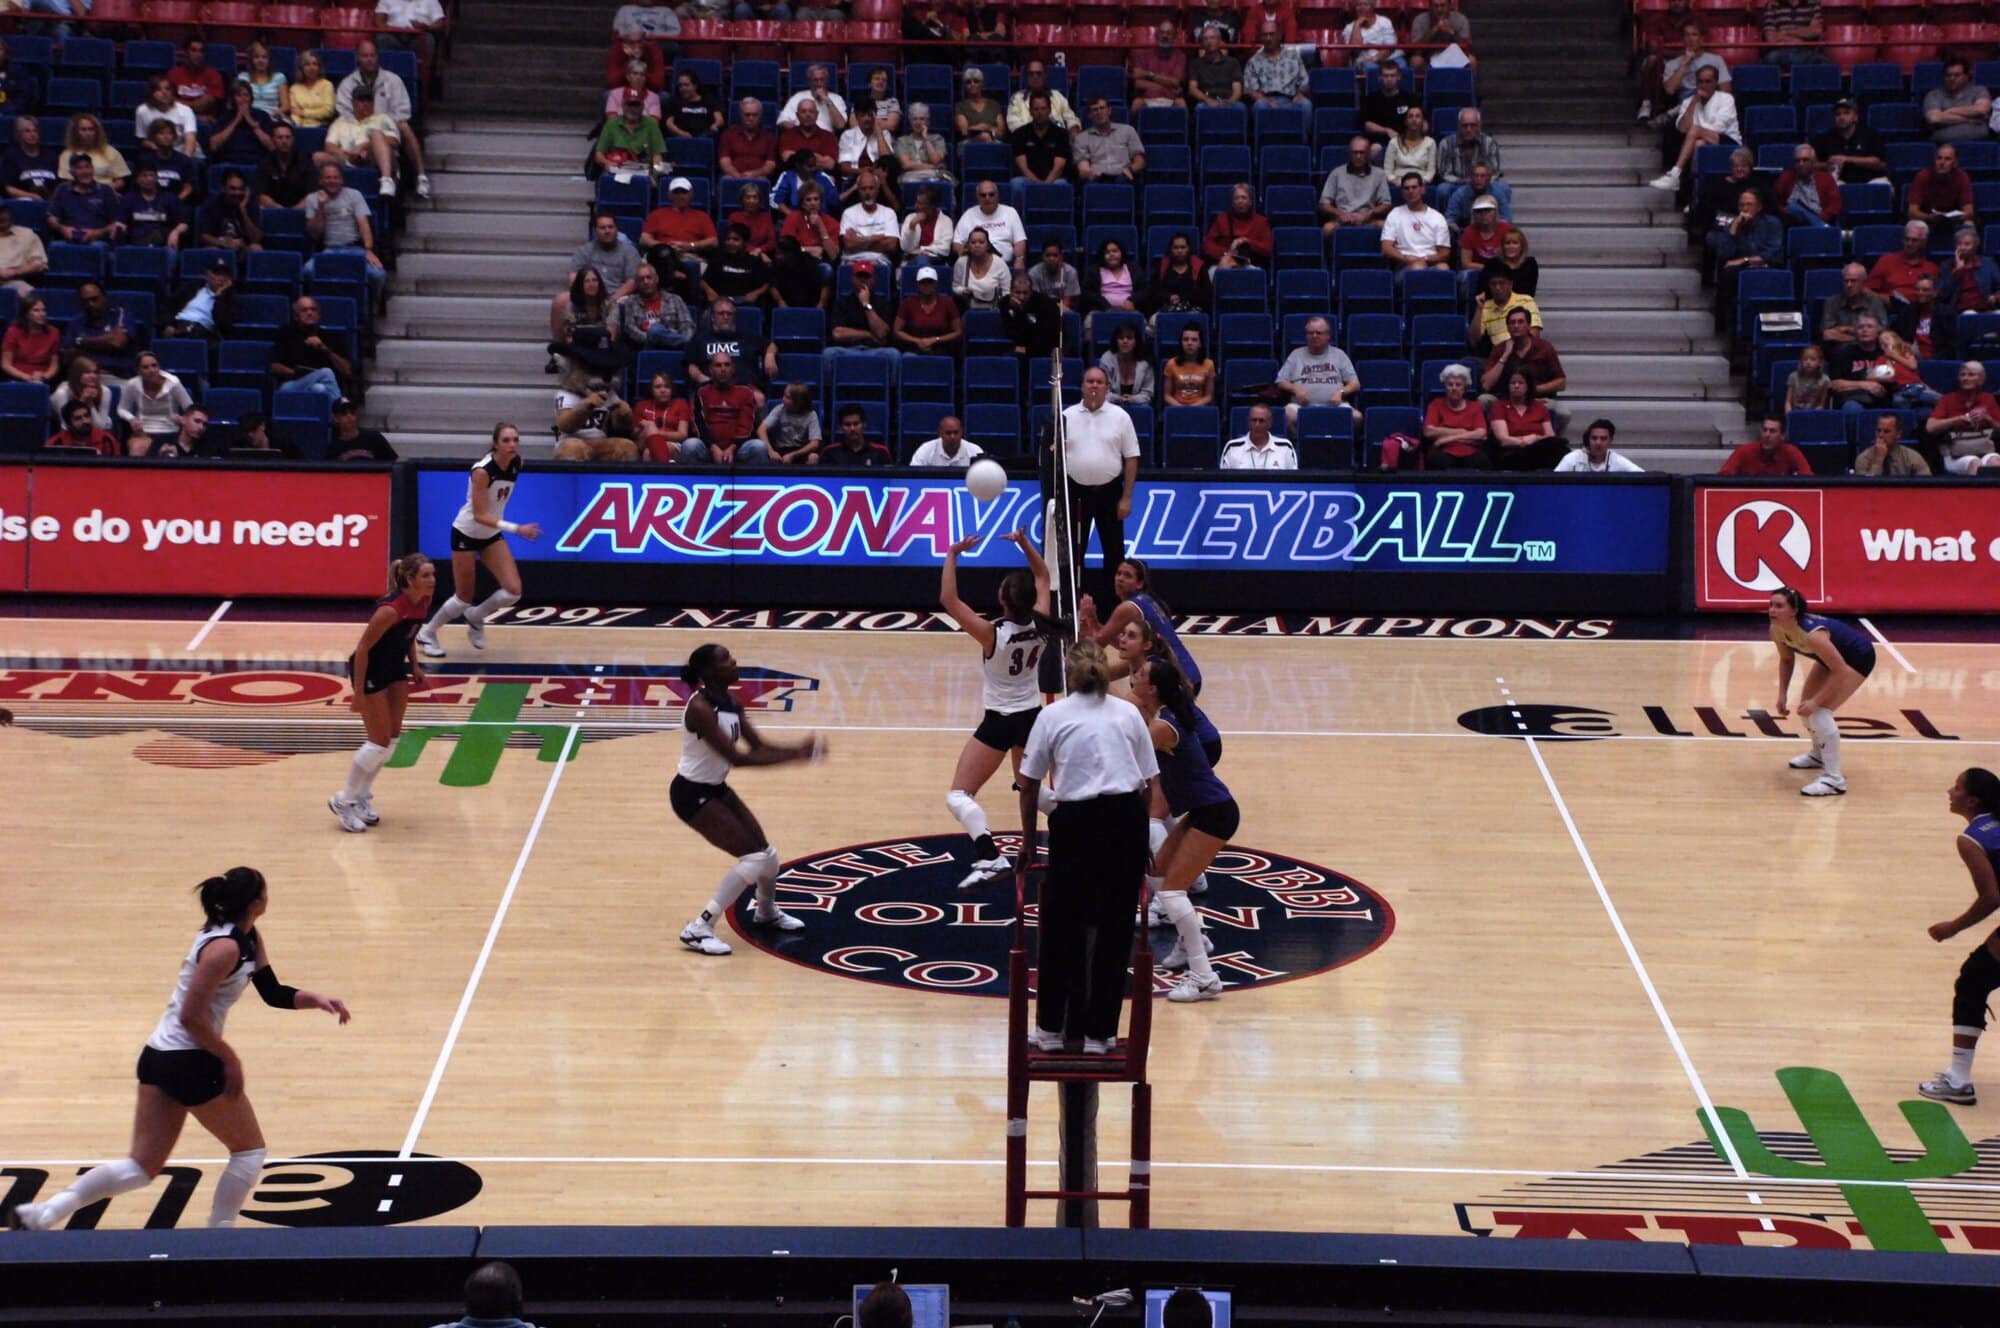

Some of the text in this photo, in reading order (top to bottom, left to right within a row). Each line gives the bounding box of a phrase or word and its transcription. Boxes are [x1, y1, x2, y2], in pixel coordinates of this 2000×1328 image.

[706, 342, 740, 355] UMC
[73, 509, 130, 542] do
[142, 518, 221, 551] you
[233, 513, 368, 548] need?
[556, 482, 953, 556] ARIZONA
[953, 486, 1521, 562] VLEYBALL
[1860, 528, 1976, 562] What
[485, 606, 1615, 640] 1997 NATION HAMPIONS
[1008, 647, 1040, 676] 34
[1204, 850, 1373, 921] OBBI
